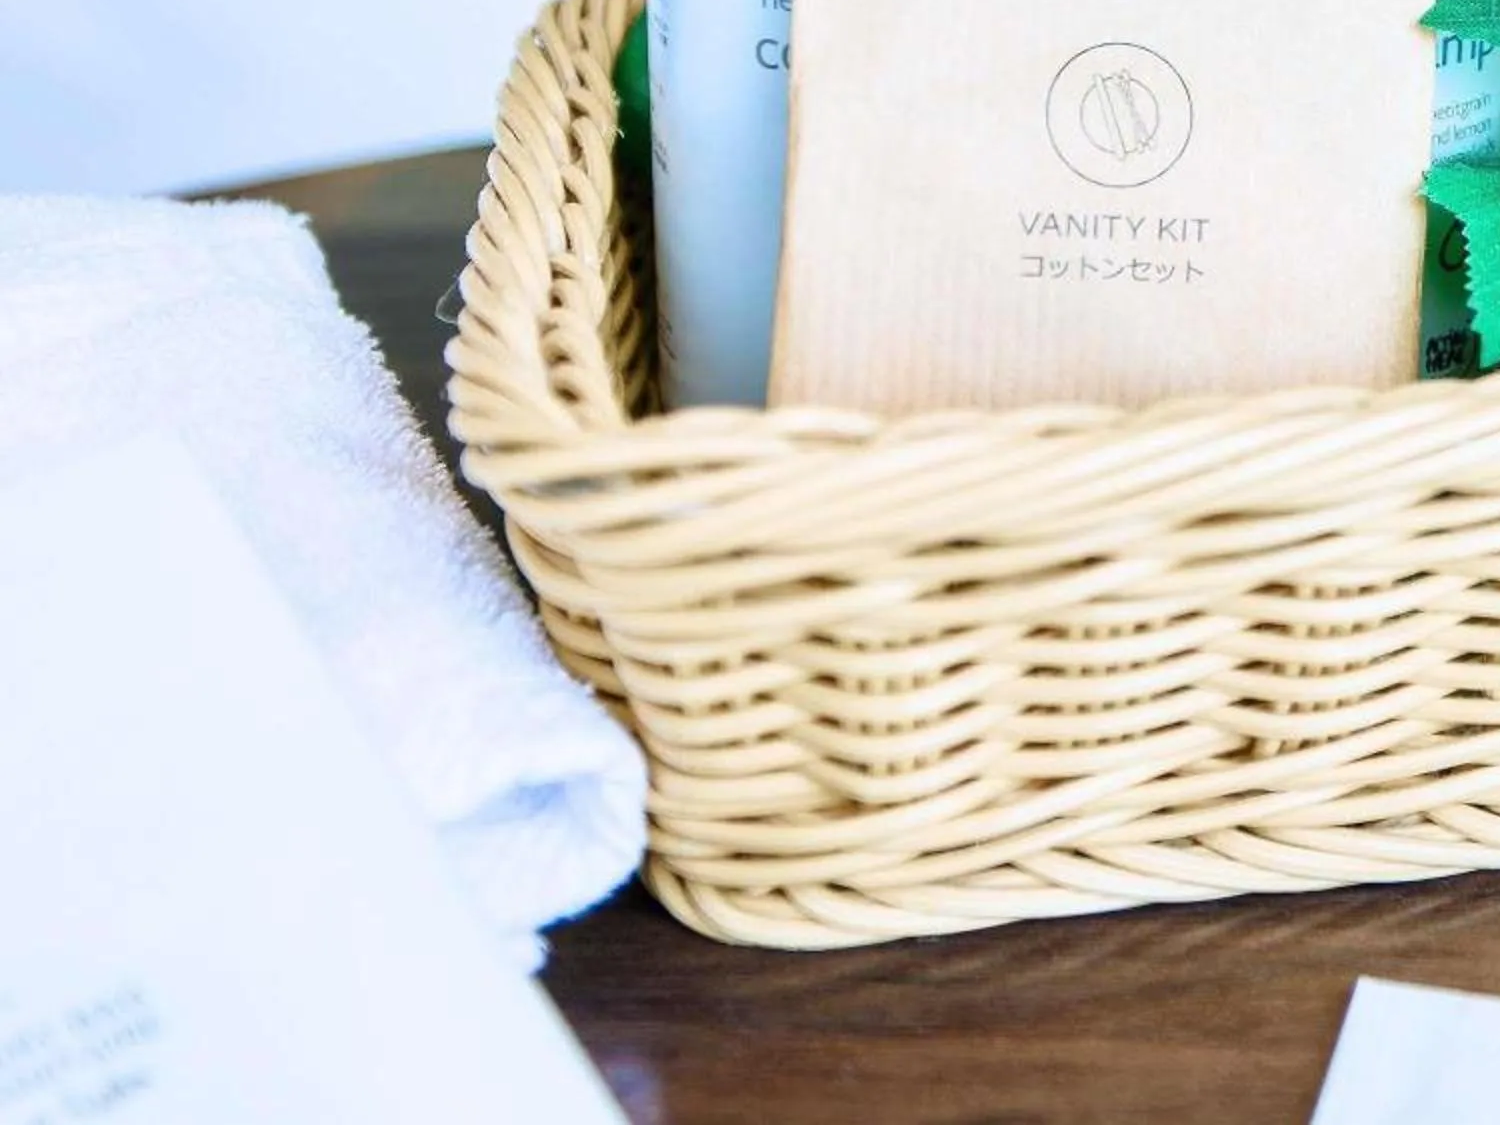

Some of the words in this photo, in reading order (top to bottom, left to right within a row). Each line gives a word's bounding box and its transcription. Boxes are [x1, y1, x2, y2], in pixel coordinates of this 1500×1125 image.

[1018, 211, 1147, 240] VANITY
[1158, 218, 1211, 243] KIT
[1020, 255, 1206, 283] コットンセット
